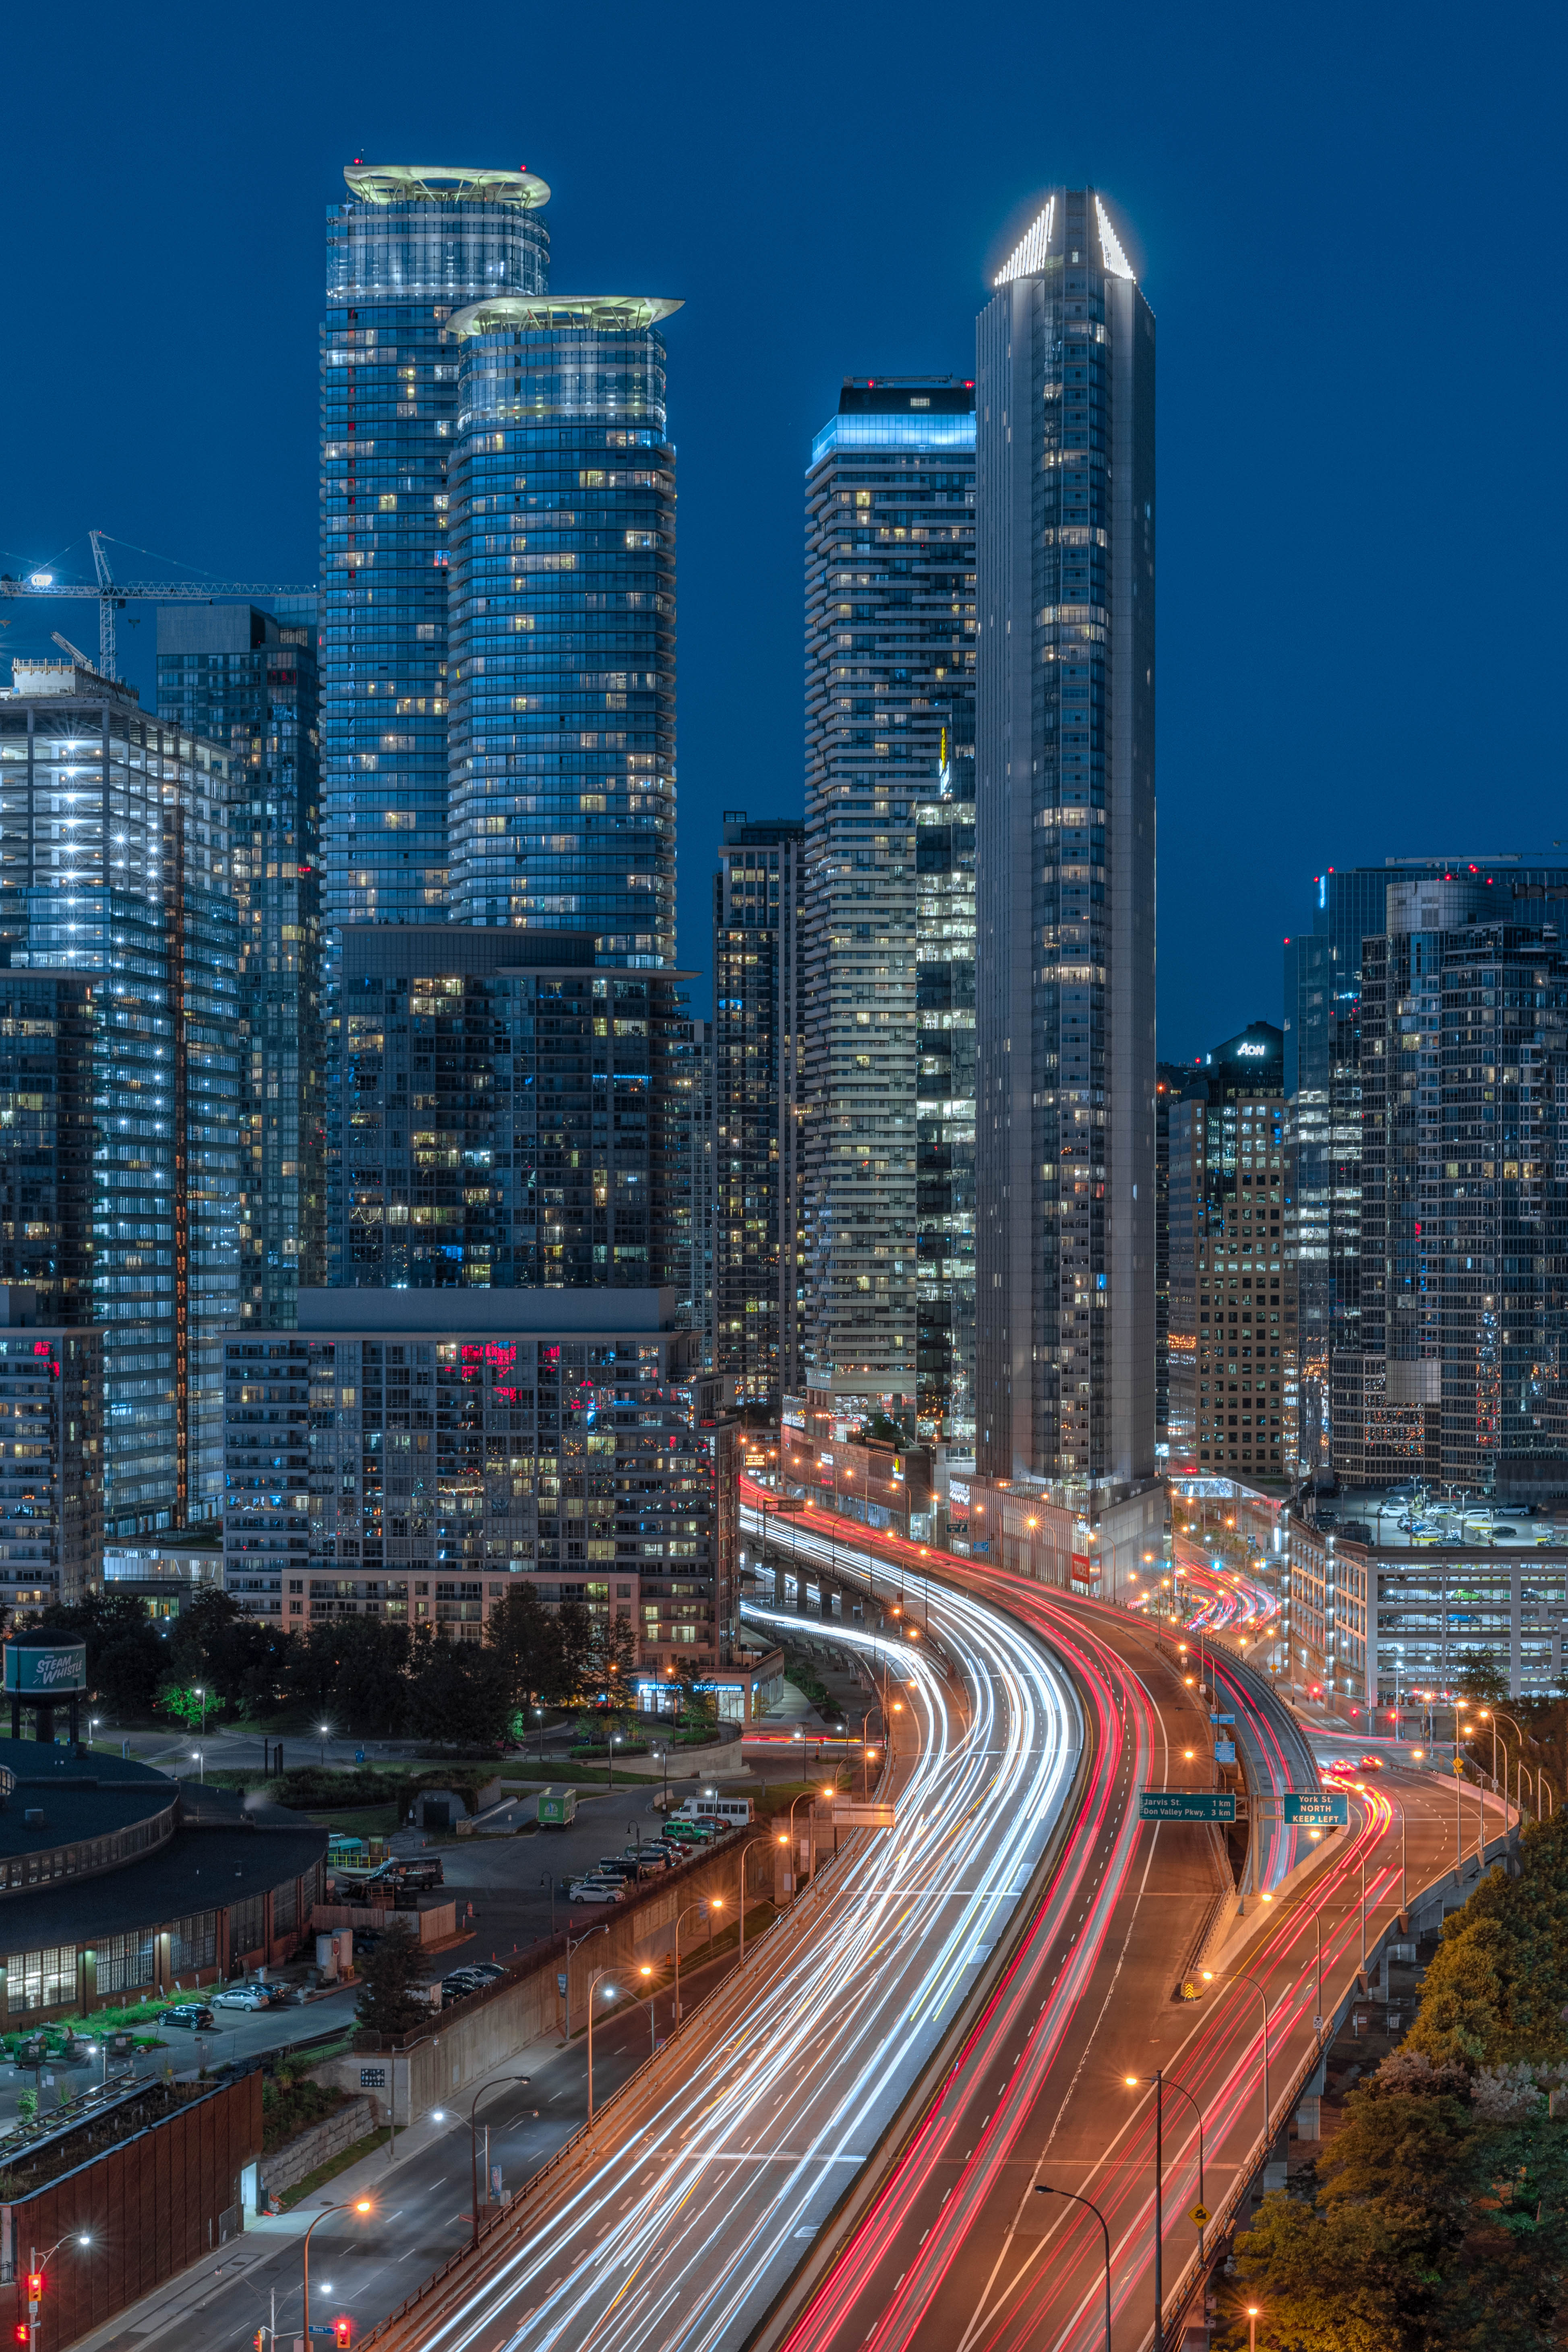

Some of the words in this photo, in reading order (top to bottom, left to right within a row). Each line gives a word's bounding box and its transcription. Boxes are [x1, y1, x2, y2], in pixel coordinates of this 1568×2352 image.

[1074, 1560, 1088, 1577] TRIDEL
[36, 1655, 72, 1673] STEAM
[43, 1660, 82, 1684] WHISTLE
[1160, 1808, 1182, 1816] Valley
[1185, 1809, 1205, 1817] Pkwy.
